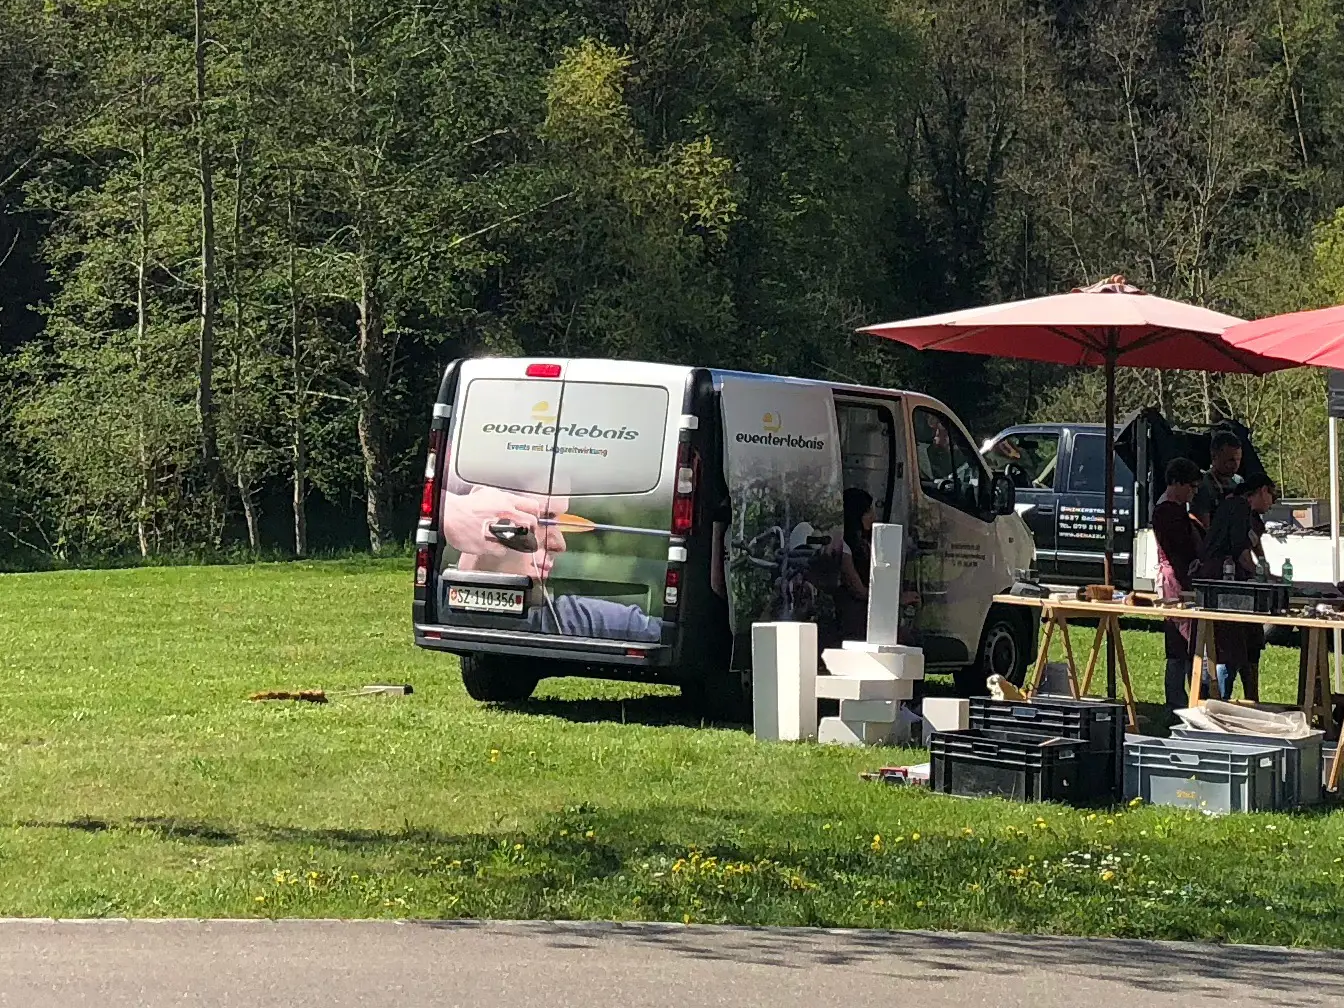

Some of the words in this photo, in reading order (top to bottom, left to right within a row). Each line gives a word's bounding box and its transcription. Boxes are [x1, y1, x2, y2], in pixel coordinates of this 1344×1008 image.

[482, 421, 639, 441] eventerlebnis
[507, 442, 530, 451] Events
[531, 444, 544, 452] mit
[736, 432, 824, 450] eventerlebnis
